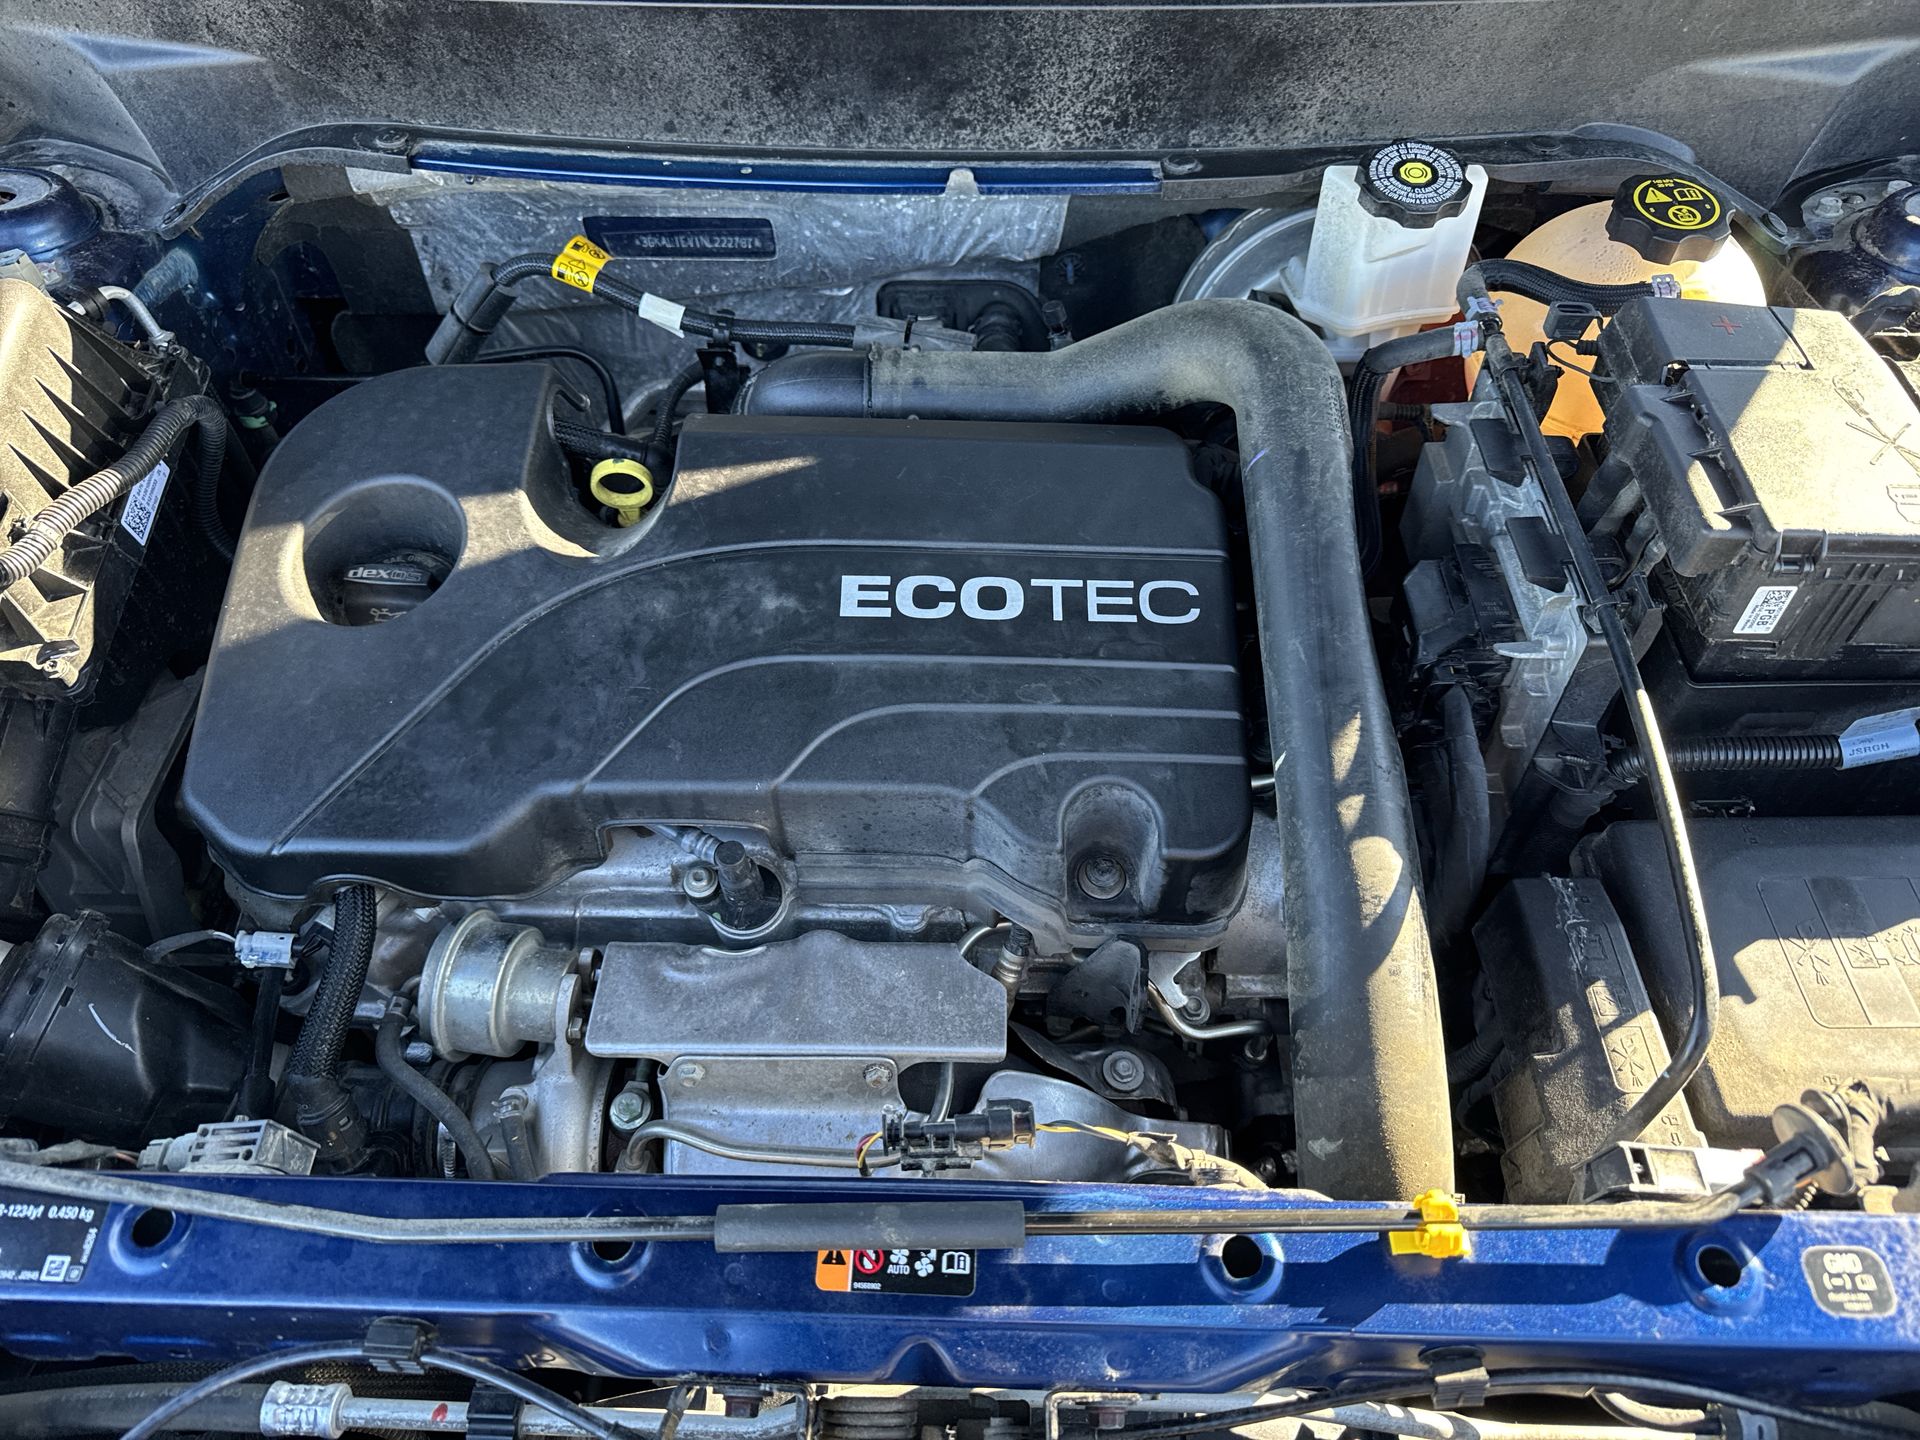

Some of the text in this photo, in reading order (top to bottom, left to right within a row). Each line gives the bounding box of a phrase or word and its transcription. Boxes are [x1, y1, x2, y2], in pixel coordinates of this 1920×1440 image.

[347, 566, 422, 581] dexos
[839, 574, 1201, 624] ECOTEC
[1757, 609, 1775, 626] PGB
[1849, 742, 1890, 756] JSRGH
[48, 1205, 79, 1219] 0.450
[79, 1206, 95, 1223] kg
[887, 1264, 910, 1275] AUTO
